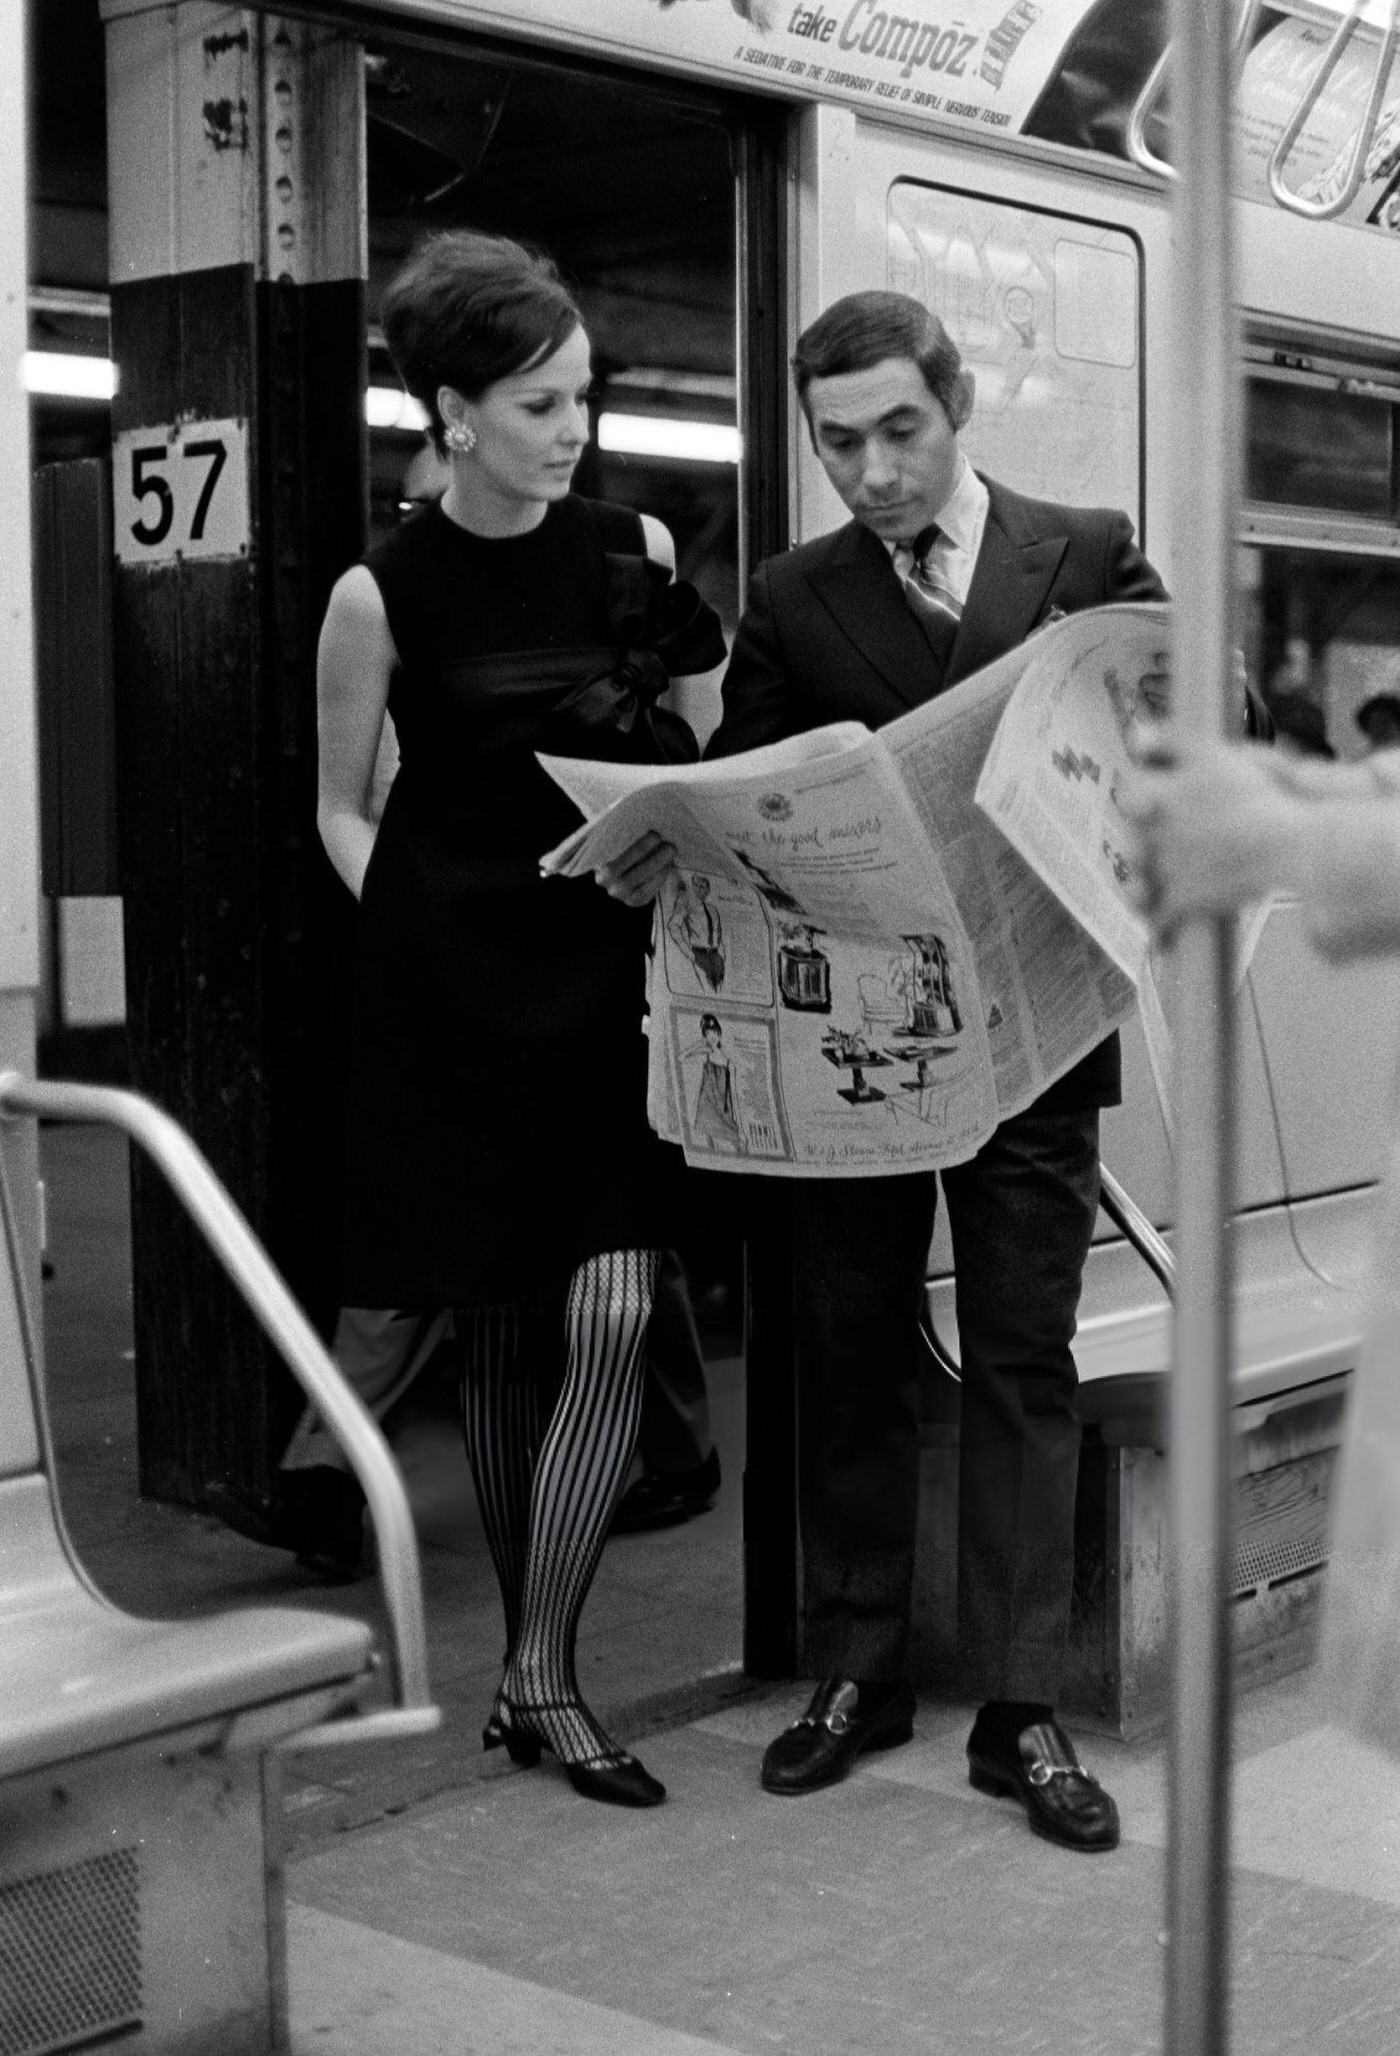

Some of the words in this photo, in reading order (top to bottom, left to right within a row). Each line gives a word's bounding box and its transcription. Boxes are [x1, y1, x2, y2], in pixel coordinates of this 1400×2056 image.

[787, 2, 837, 42] take
[734, 45, 744, 59] A
[744, 48, 787, 70] SEDATIVE
[787, 59, 806, 74] FOR
[806, 64, 823, 80] THE
[825, 69, 875, 92] TEMPORARY
[875, 82, 901, 98] RELIEF
[901, 88, 913, 101] OF
[912, 90, 942, 109] SIMPLE
[943, 100, 981, 118] NERVOUS
[131, 439, 227, 546] 57
[791, 827, 824, 852] good
